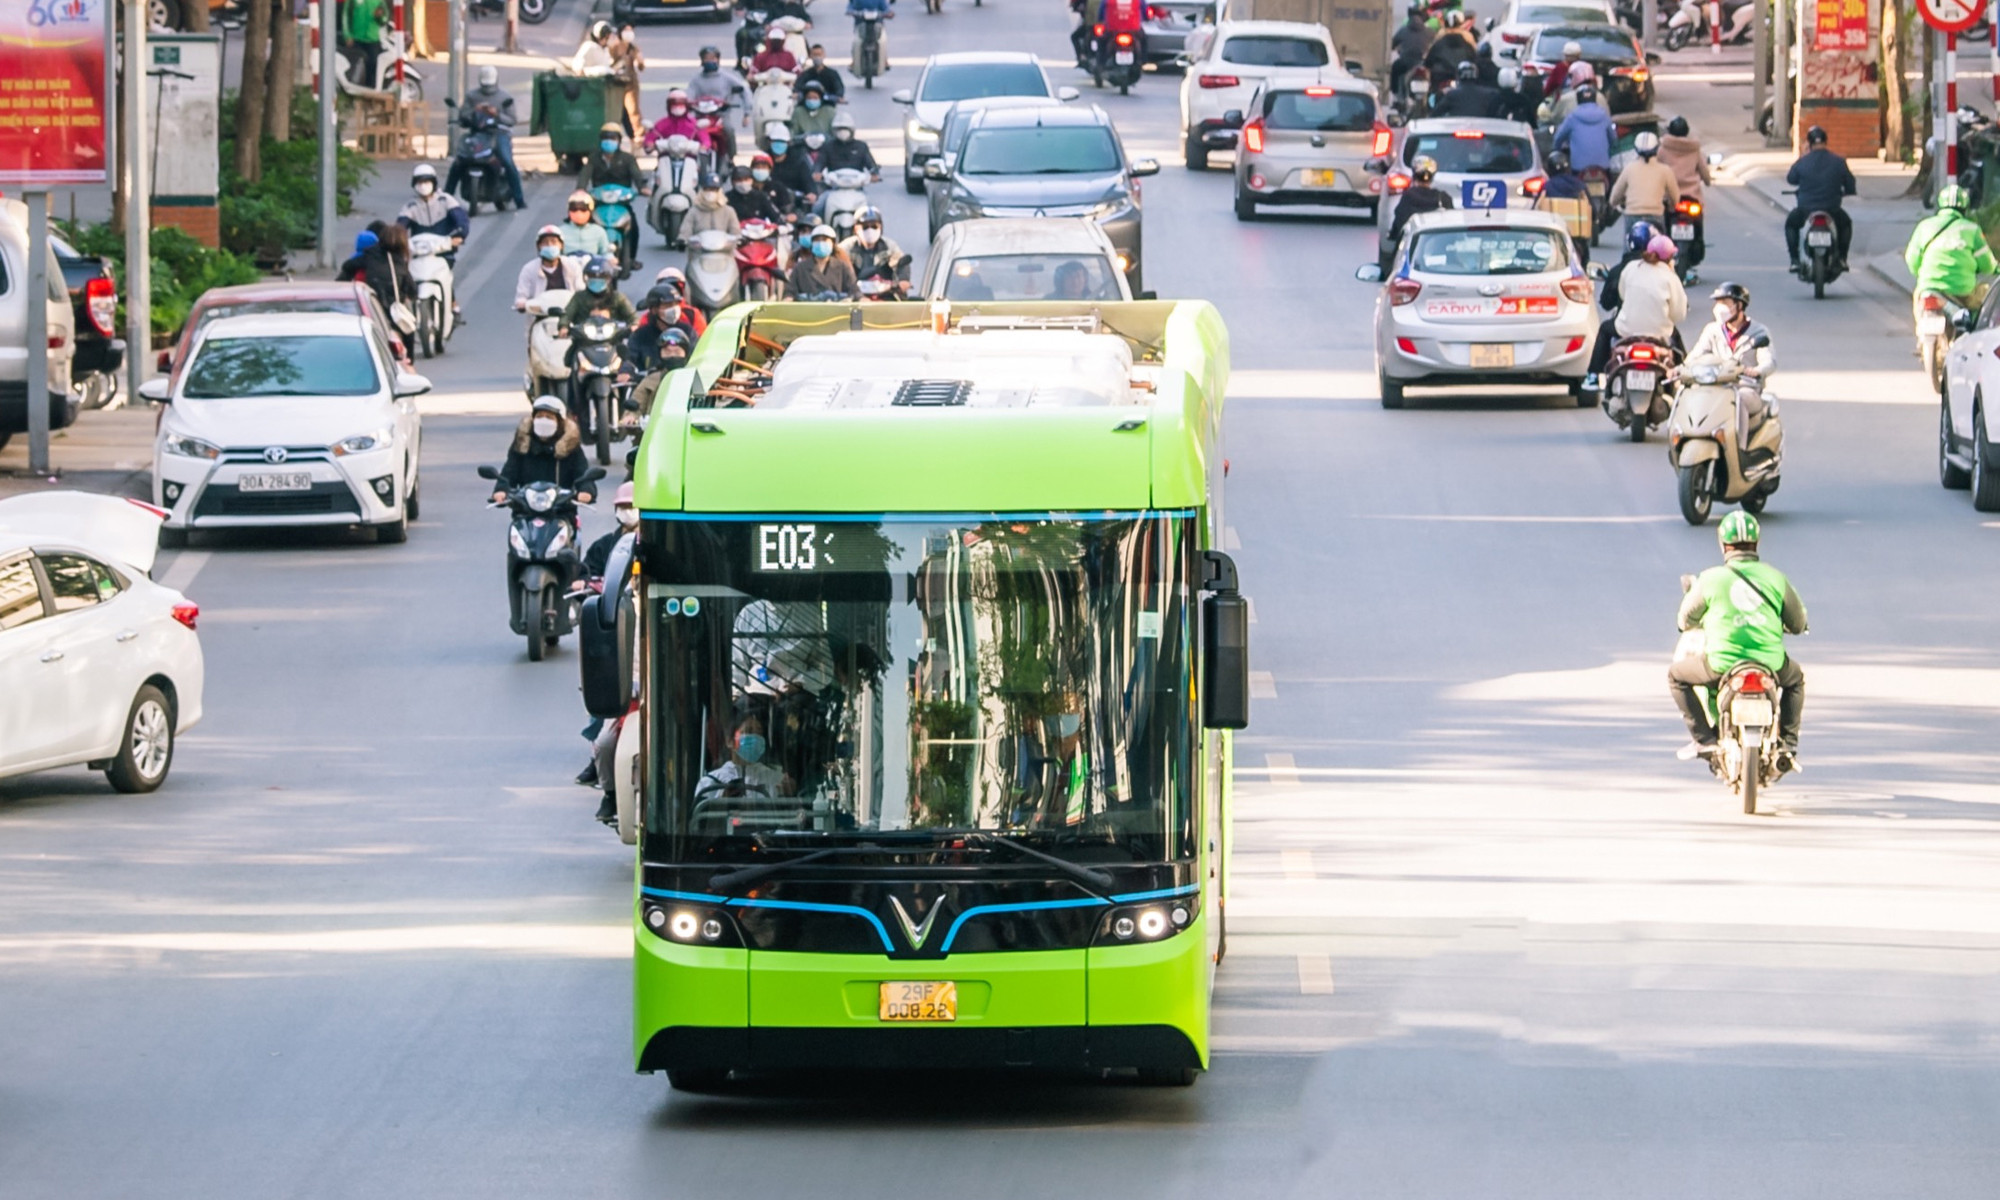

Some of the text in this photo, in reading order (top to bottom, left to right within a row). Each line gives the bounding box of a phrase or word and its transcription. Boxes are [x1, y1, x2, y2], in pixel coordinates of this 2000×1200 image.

[71, 97, 93, 108] NAM
[1472, 182, 1497, 206] G7
[1428, 305, 1481, 315] CADIVI
[1519, 298, 1527, 312] 1
[760, 525, 816, 570] E03
[902, 985, 933, 1001] 29F
